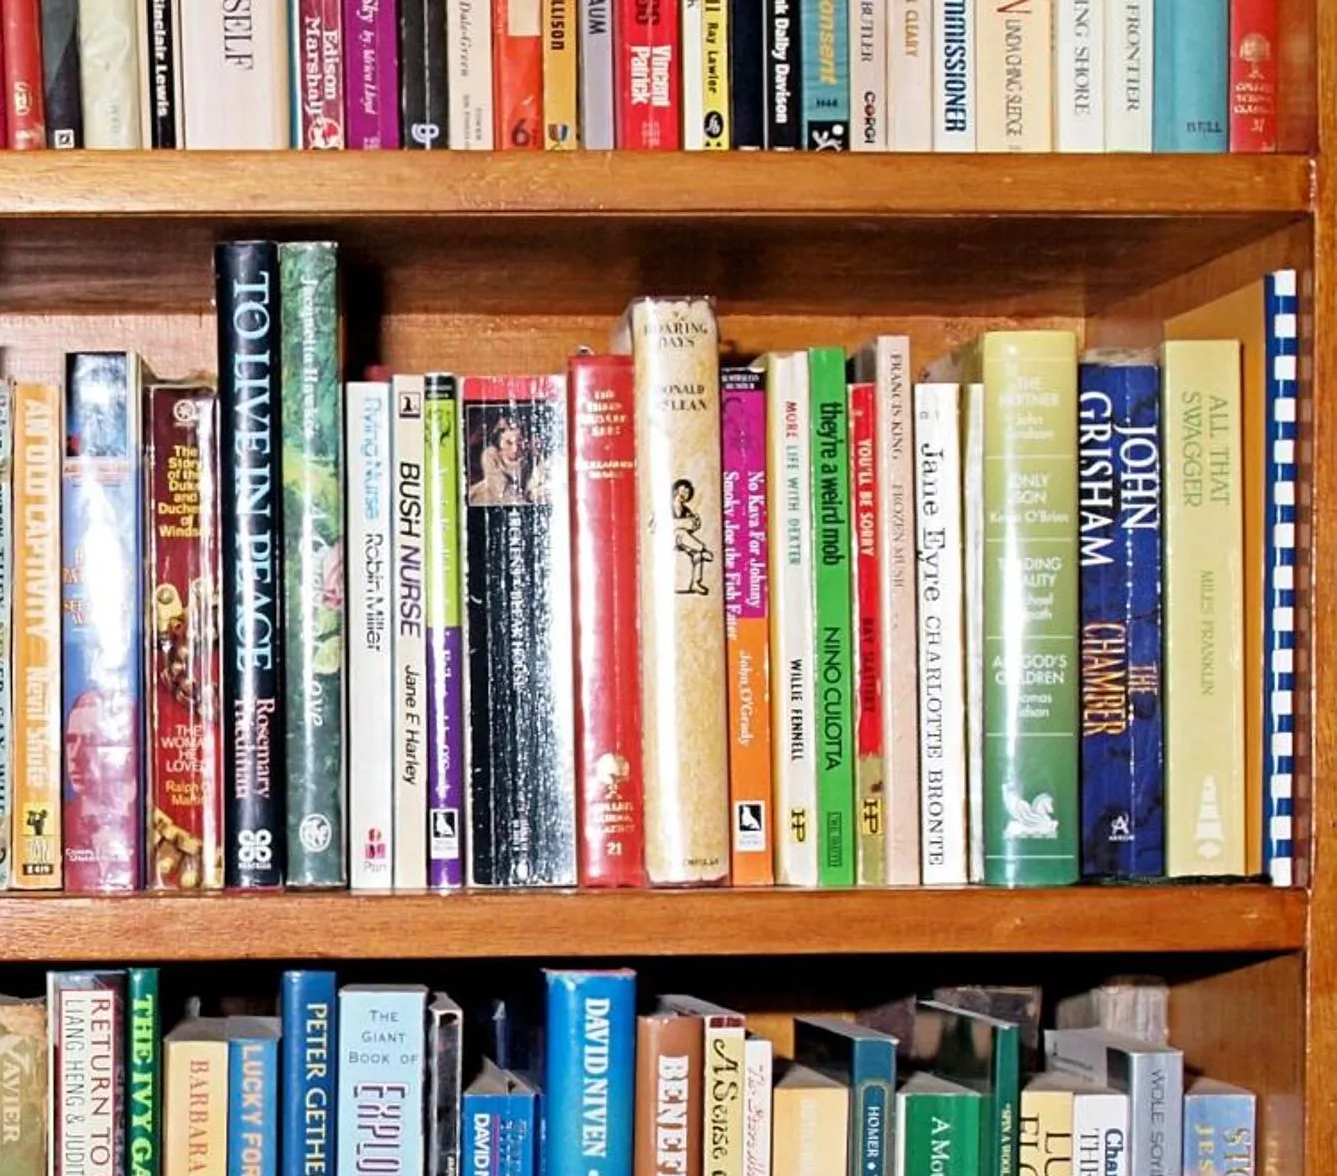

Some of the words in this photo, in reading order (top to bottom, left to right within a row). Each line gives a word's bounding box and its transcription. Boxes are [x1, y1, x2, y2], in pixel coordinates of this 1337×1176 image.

[706, 23, 719, 44] Ray
[773, 18, 790, 60] Dalby
[905, 10, 919, 57] CLEARY
[1126, 5, 1140, 112] FRONTIER
[322, 30, 339, 100] Edison
[631, 45, 652, 105] Patrick
[651, 45, 671, 107] Vincent
[708, 51, 719, 93] Lawler
[775, 64, 792, 123] Davison
[1074, 46, 1089, 114] SHORE
[864, 91, 876, 144] CORGI
[1006, 94, 1022, 136] SLEDGE
[234, 271, 268, 339] TO
[235, 352, 269, 453] LIVE
[786, 402, 799, 439] MORE
[1209, 394, 1228, 438] ALL
[787, 445, 800, 472] LIFE
[822, 464, 839, 474] a
[1114, 424, 1156, 530] JOHN
[1181, 392, 1201, 507] SWAGGER
[1210, 448, 1230, 506] THAT
[237, 462, 270, 516] IN
[400, 462, 420, 537] BUSH
[787, 477, 800, 513] WITH
[822, 477, 844, 523] weird
[921, 443, 945, 517] Jane
[1080, 392, 1112, 566] GRISHAM
[787, 518, 802, 566] DEXTER
[822, 526, 844, 566] mob
[919, 528, 946, 602] Eyre
[236, 531, 271, 671] PEACE
[400, 544, 421, 638] NURSE
[1201, 571, 1215, 615] MILES
[790, 659, 804, 702] WILLIE
[824, 627, 841, 684] NINO
[1084, 622, 1126, 734] CHAMBER
[1127, 661, 1156, 694] THE
[1201, 621, 1215, 696] FRANKLIN
[403, 665, 421, 706] Jane
[926, 616, 943, 759] CHARLOTTE
[406, 711, 419, 724] E
[791, 708, 804, 761] FENNELL
[824, 687, 841, 771] CULOTTA
[253, 699, 274, 798] Rosemary
[402, 729, 421, 786] Harley
[927, 769, 944, 866] BRONTE
[866, 1106, 880, 1158] HOMER
